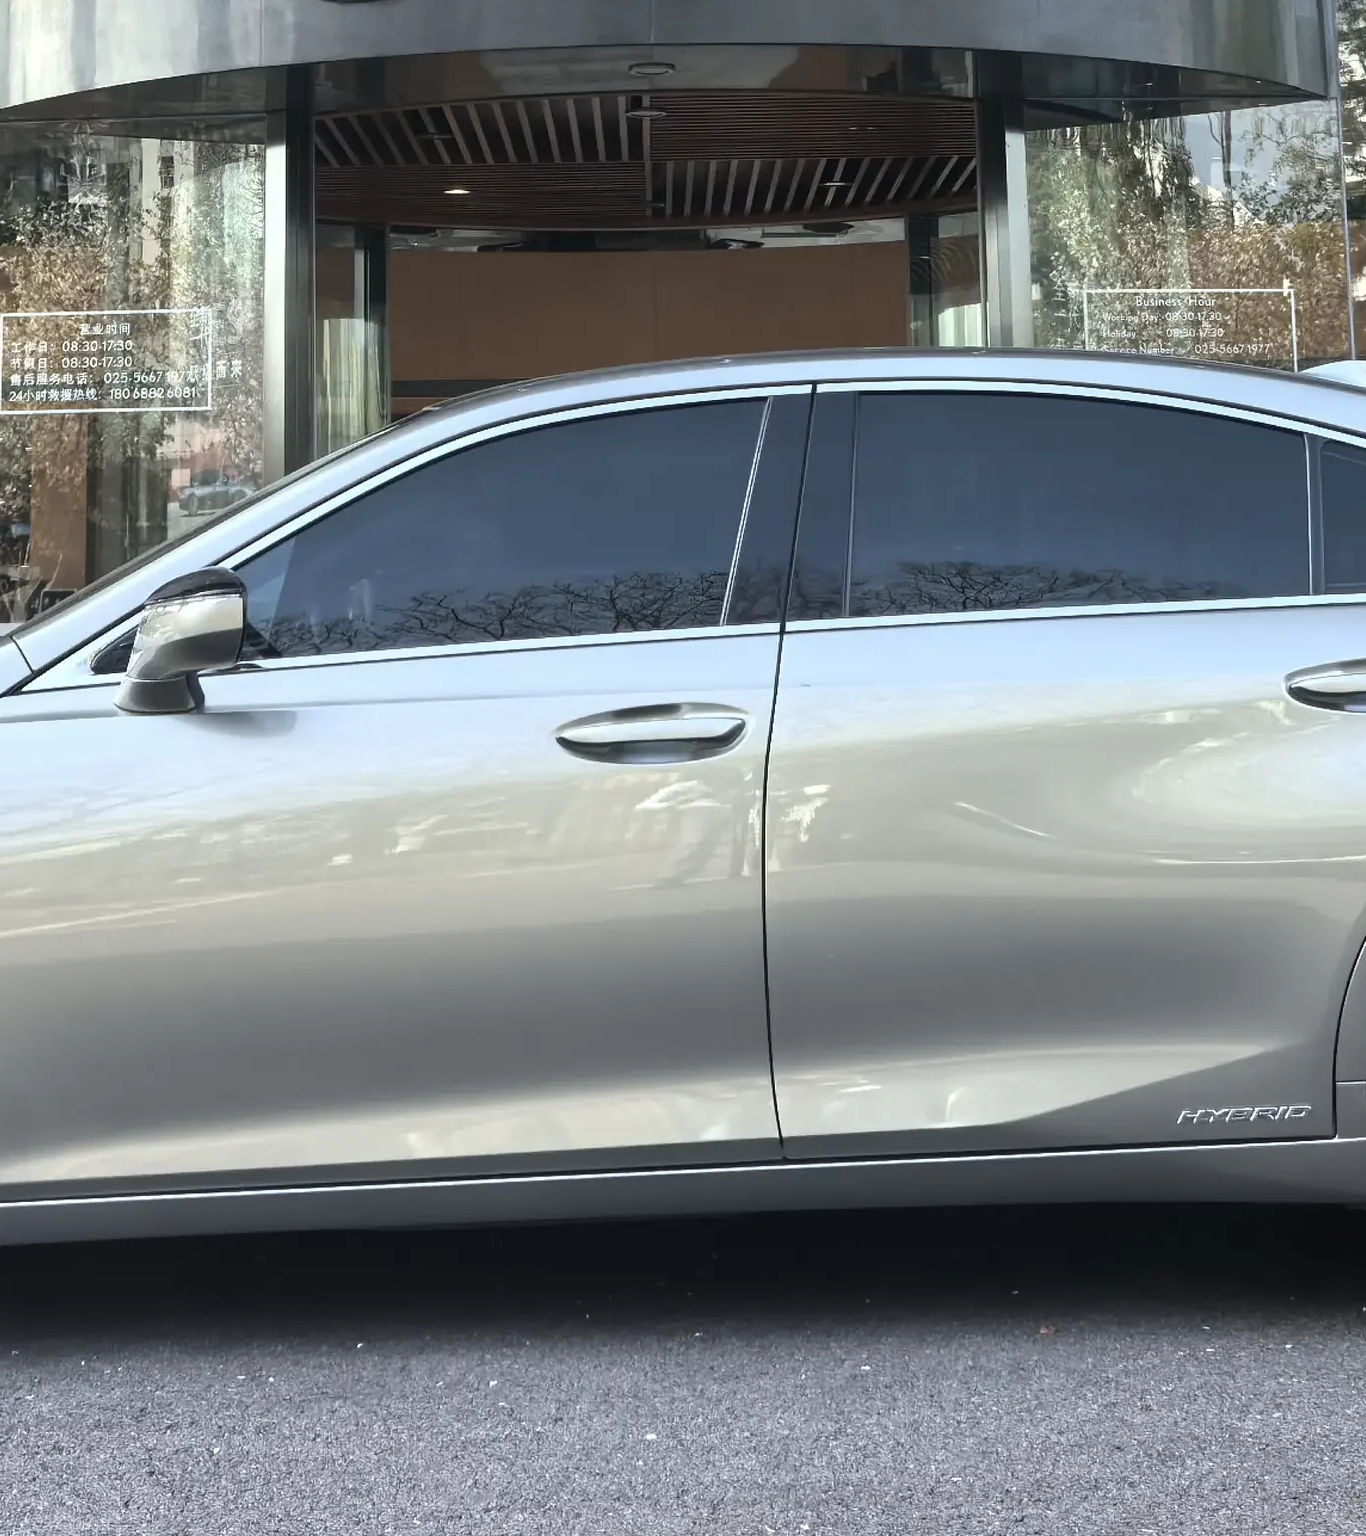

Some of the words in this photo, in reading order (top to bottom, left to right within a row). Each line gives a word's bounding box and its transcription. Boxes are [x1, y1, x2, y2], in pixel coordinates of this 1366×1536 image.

[1136, 296, 1182, 307] Business
[1188, 296, 1217, 307] Hour
[78, 322, 131, 336] 营业时间
[62, 339, 133, 352] 08:30-17:30
[61, 356, 133, 369] 08:30-17:30
[1176, 1105, 1312, 1125] HYBRID
